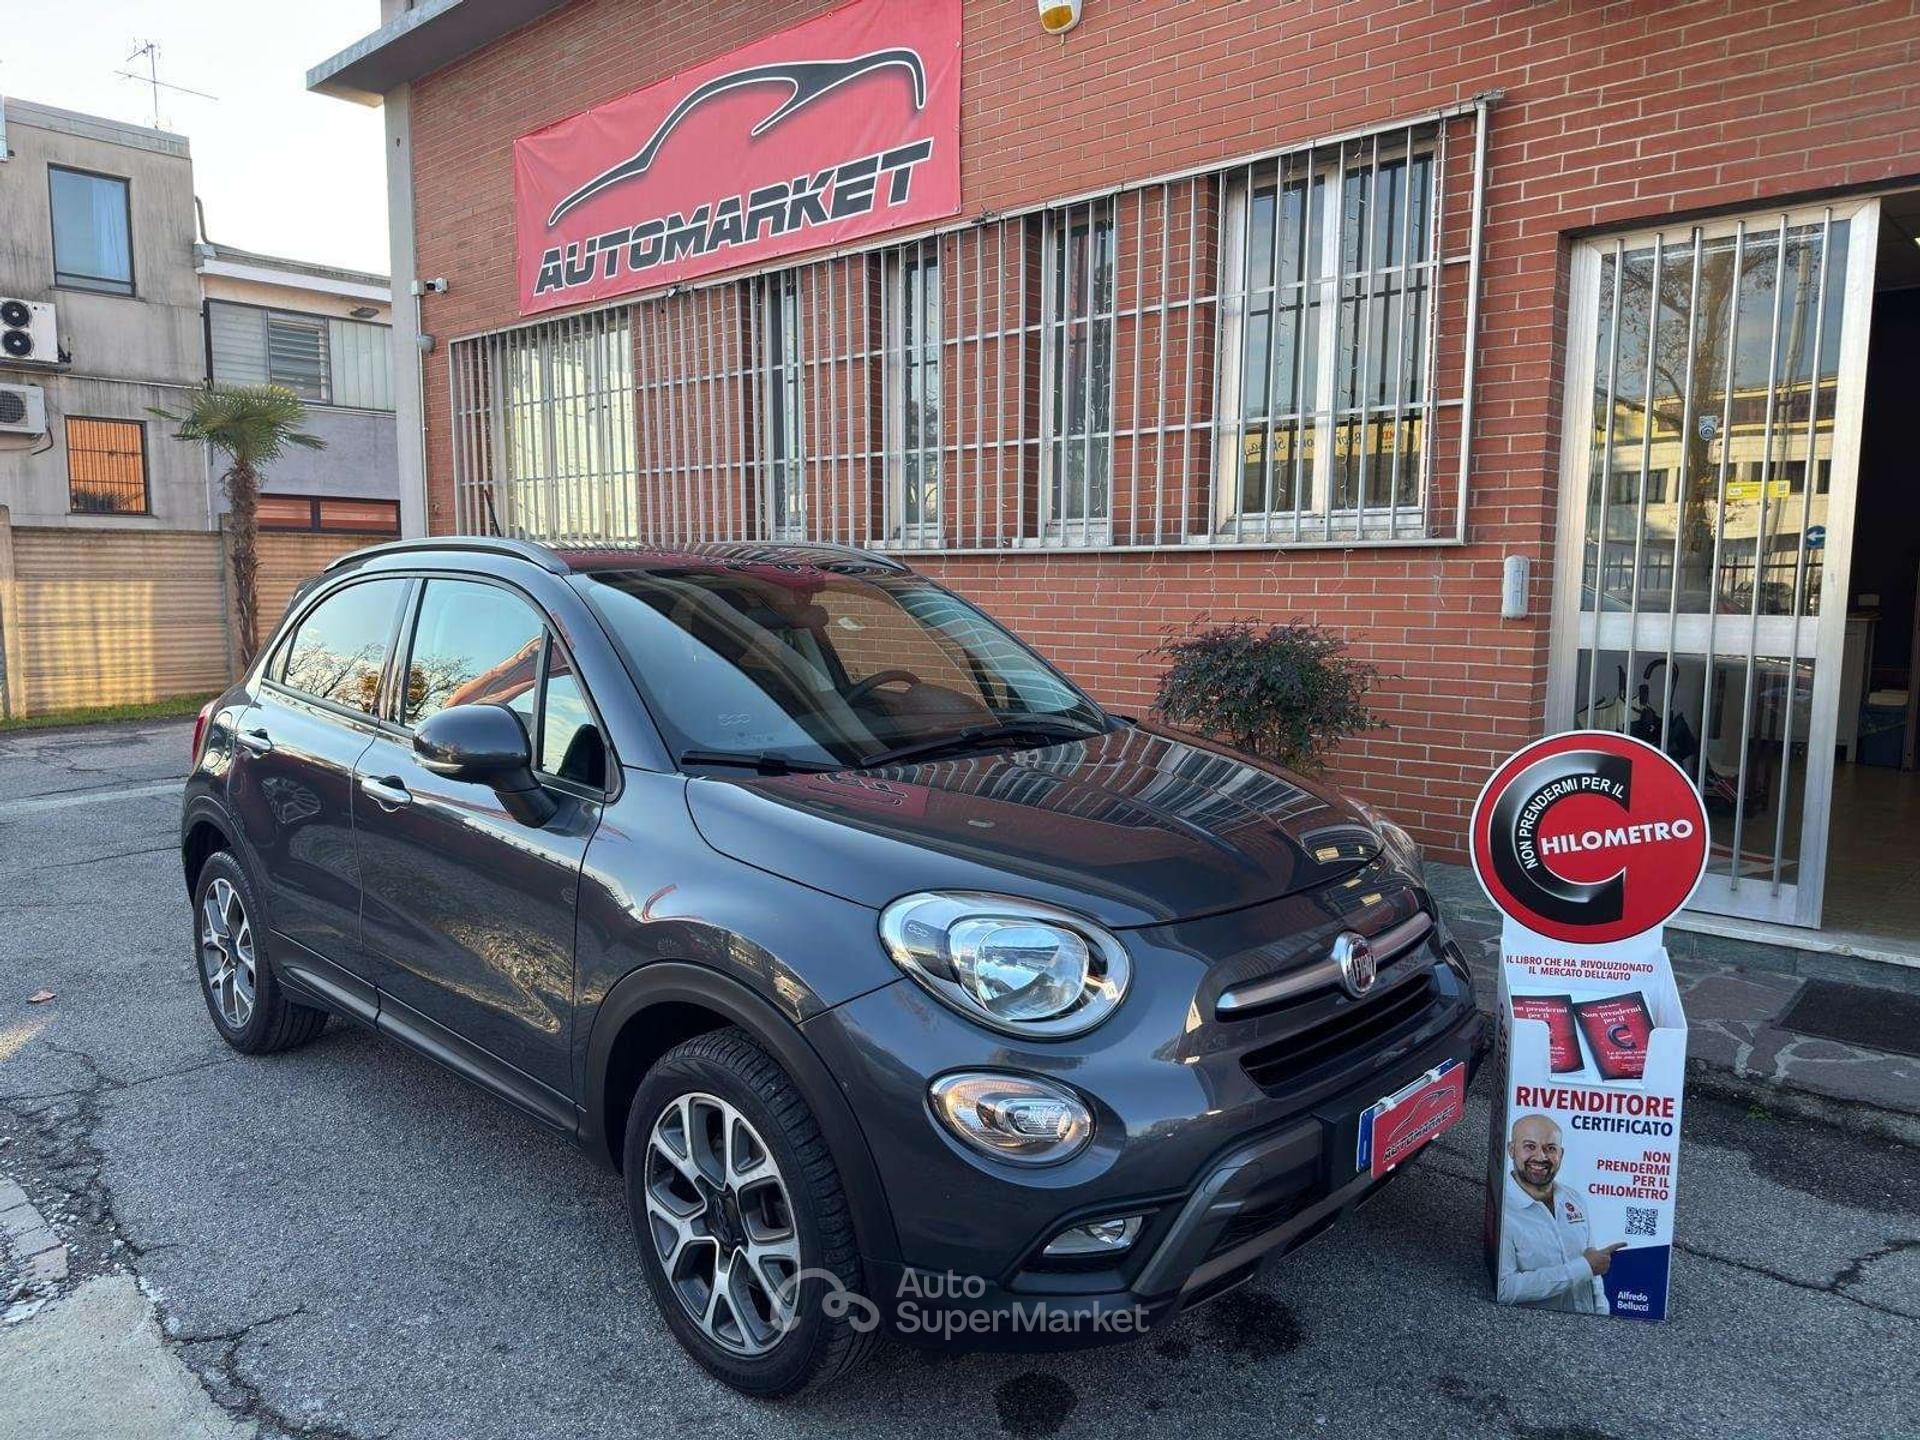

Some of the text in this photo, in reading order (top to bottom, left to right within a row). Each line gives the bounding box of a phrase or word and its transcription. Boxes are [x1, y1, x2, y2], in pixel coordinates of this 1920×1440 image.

[533, 136, 934, 297] AUTOMARKET
[1519, 776, 1625, 870] NON PRENDERMI PER IL
[1506, 955, 1654, 973] IL LIBRO CHE HA RIVOLUZIONATO
[1528, 966, 1631, 981] IL MERCATO DELL'AUTO
[1516, 1086, 1675, 1119] RIVENDITORE
[1571, 1114, 1673, 1137] CERTIFICATO
[1643, 1150, 1671, 1164] NON
[1596, 1159, 1670, 1176] PRENDERMI
[1633, 1174, 1669, 1188] PER IL
[1588, 1183, 1668, 1201] CHILOMETRO
[1617, 1291, 1648, 1302] Alfredo
[1617, 1301, 1649, 1312] Bellucci
